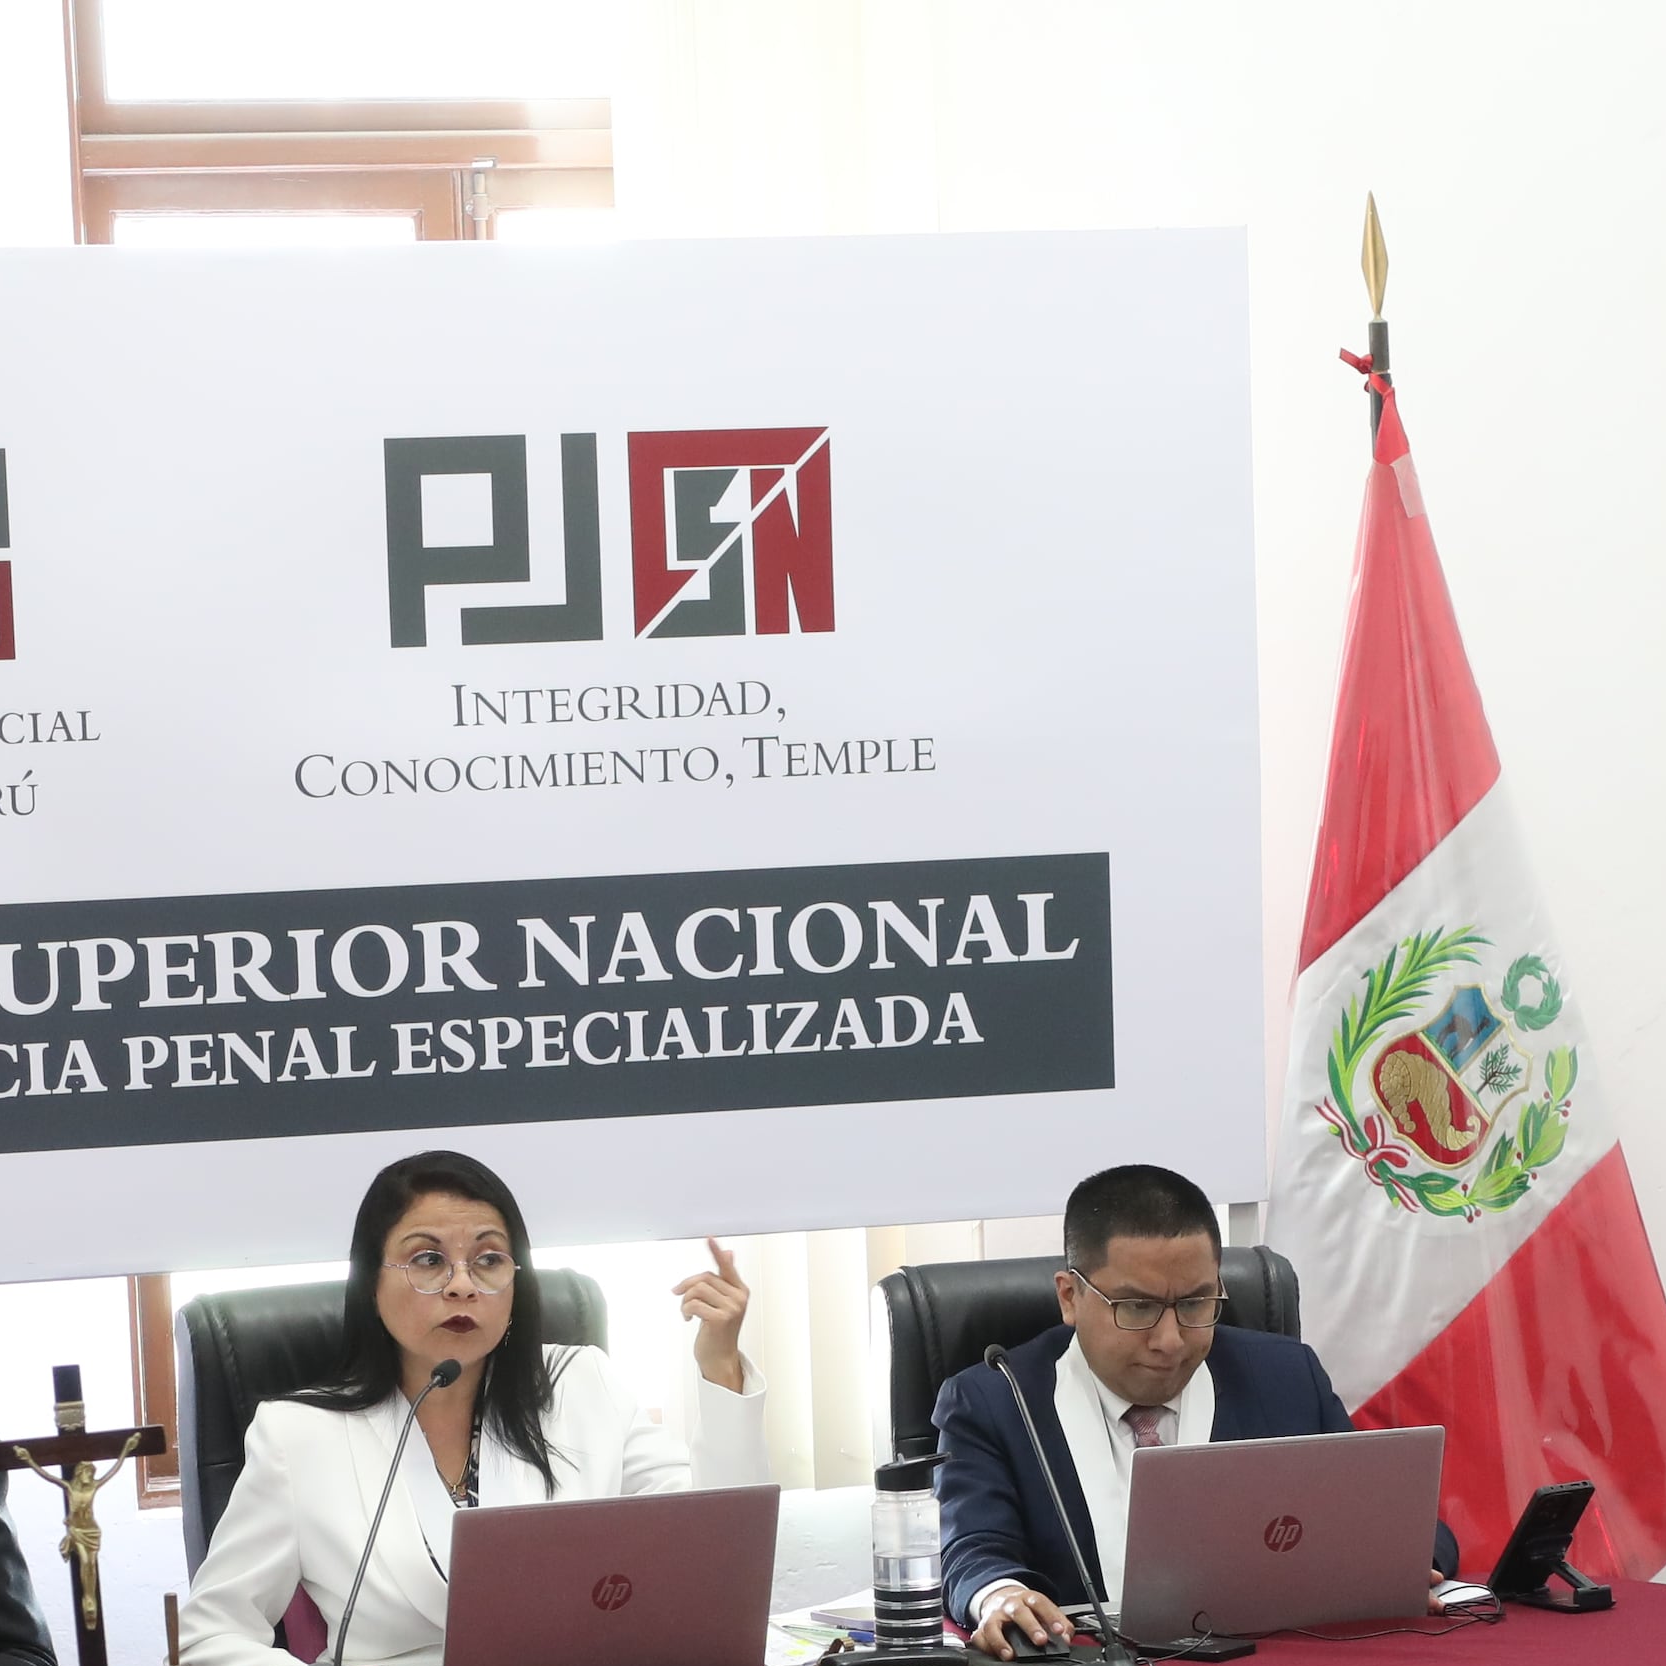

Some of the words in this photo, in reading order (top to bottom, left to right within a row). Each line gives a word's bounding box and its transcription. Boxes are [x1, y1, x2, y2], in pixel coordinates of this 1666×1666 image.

[517, 892, 1080, 989] NACIONAL
[122, 1024, 378, 1092] PENAL
[390, 992, 985, 1076] ESPECIALIZADA
[1266, 1516, 1301, 1552] hp
[595, 1575, 631, 1610] hp
